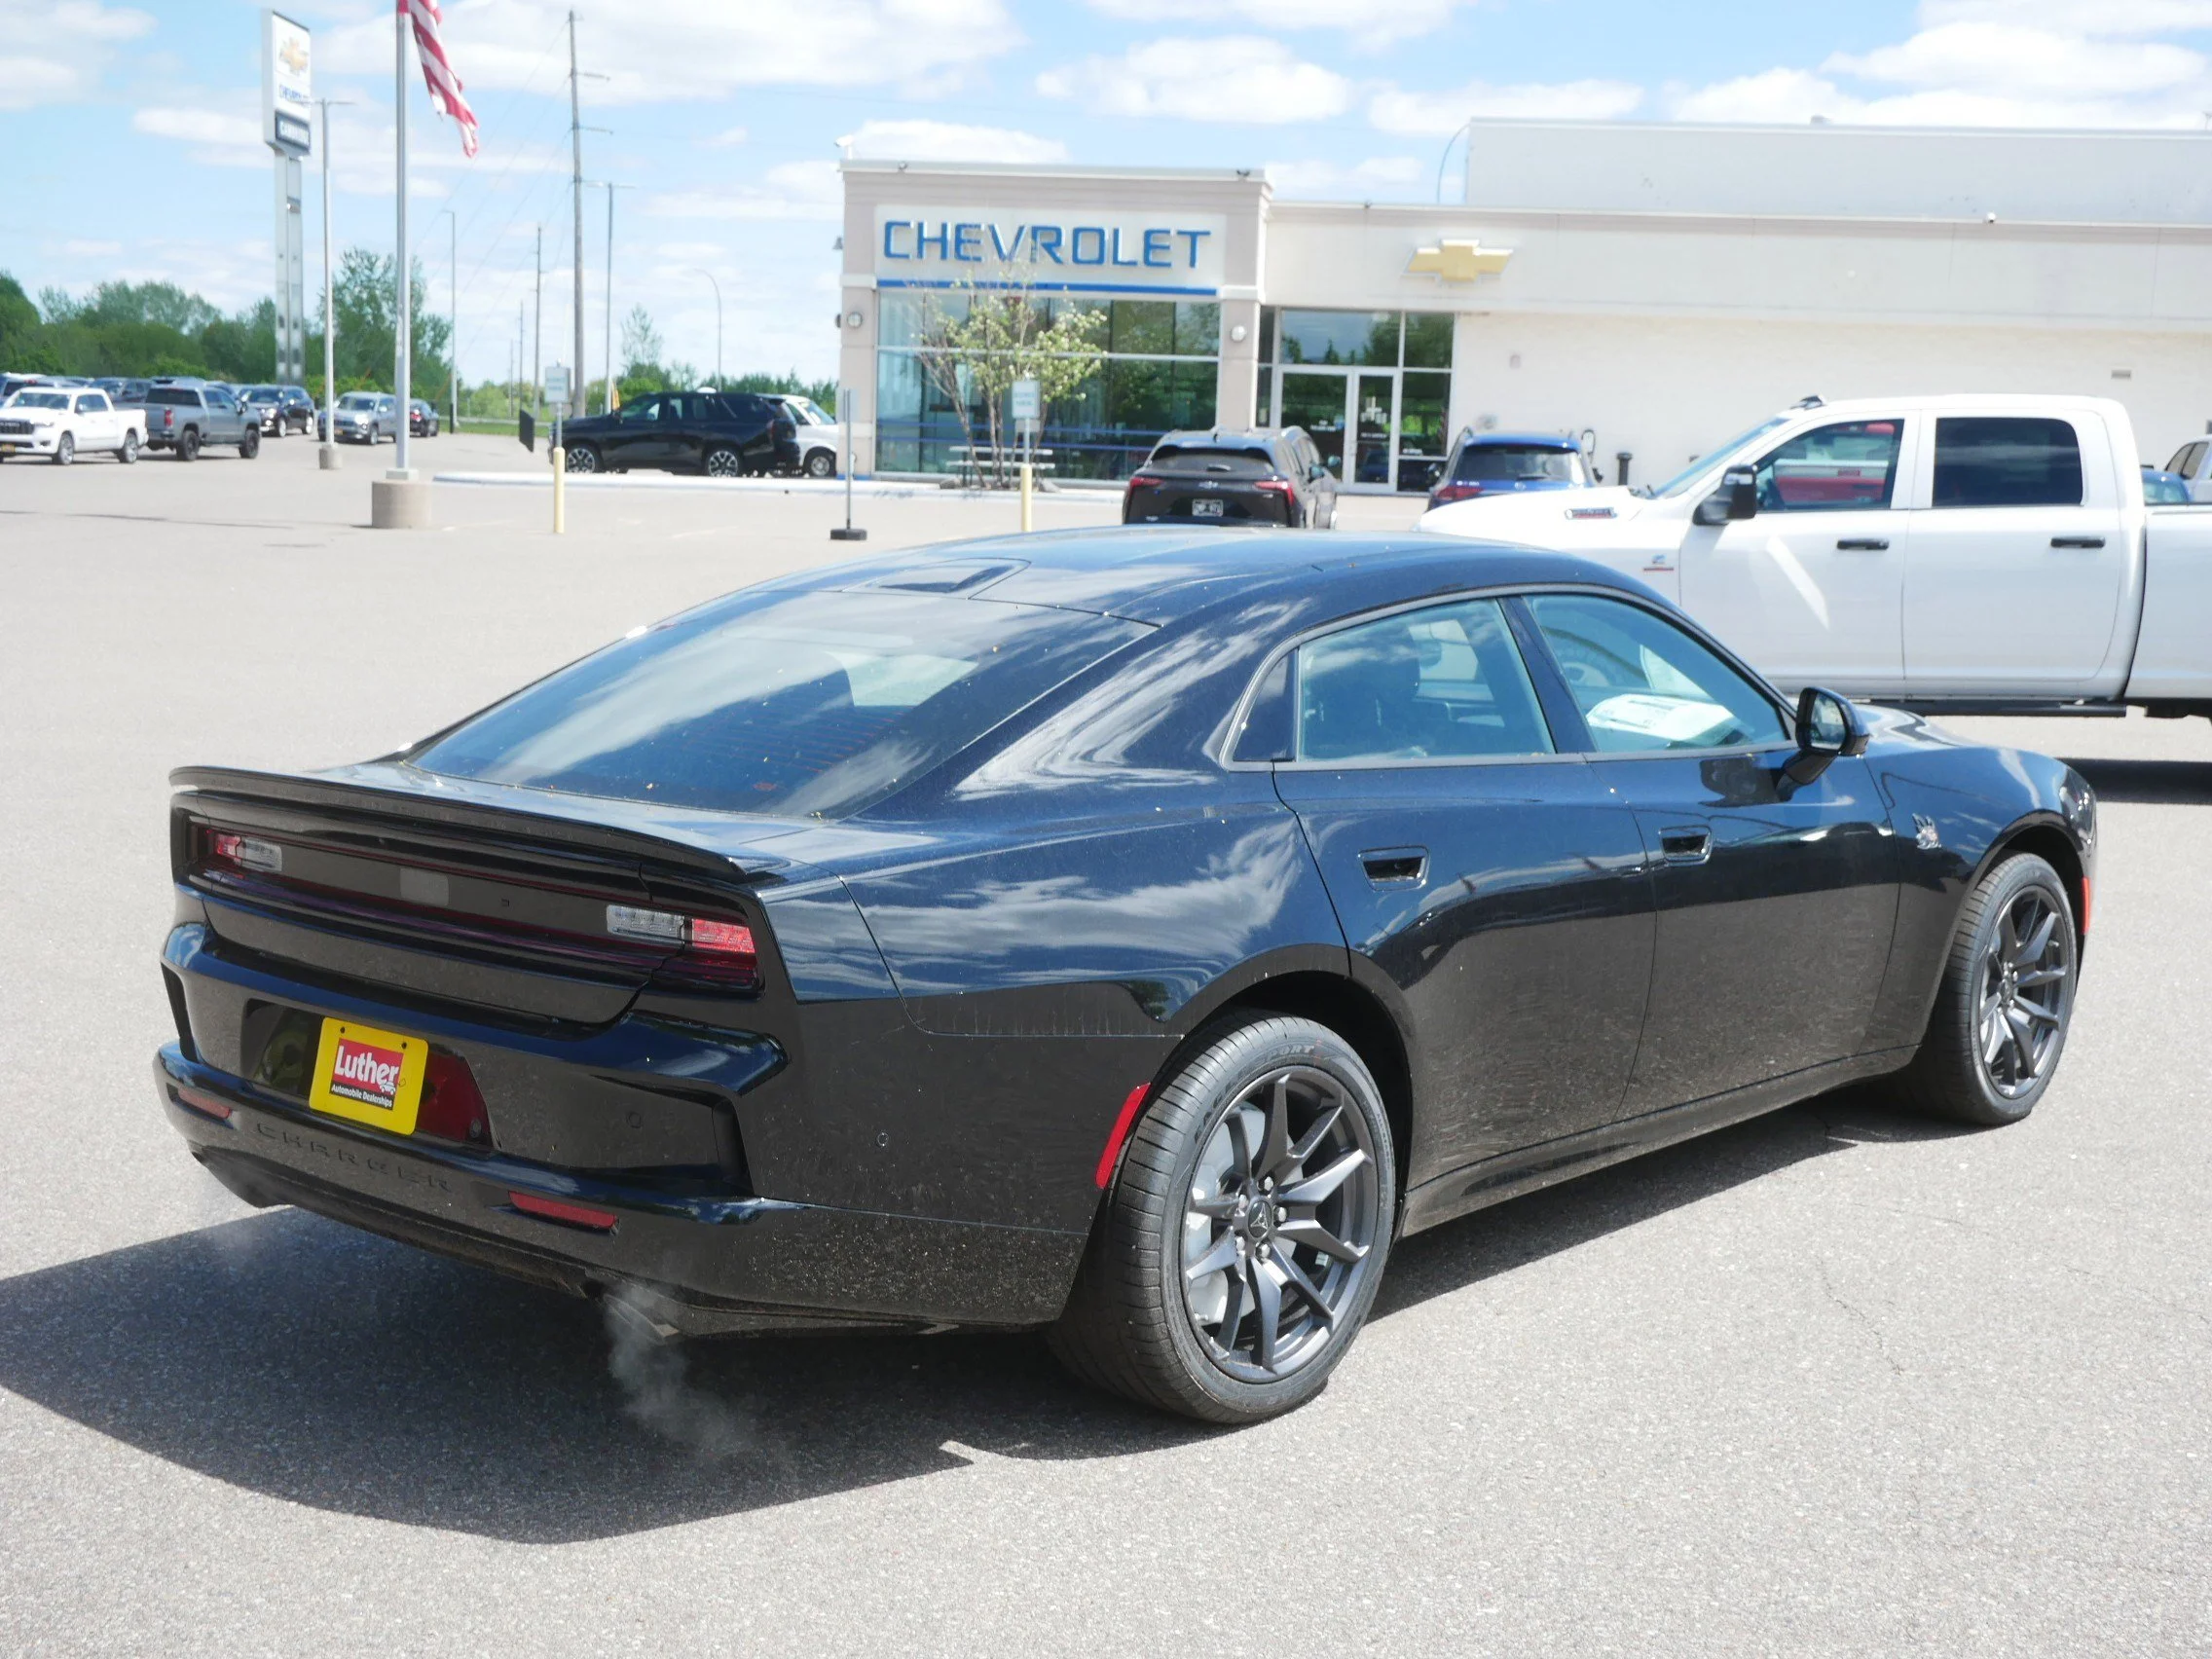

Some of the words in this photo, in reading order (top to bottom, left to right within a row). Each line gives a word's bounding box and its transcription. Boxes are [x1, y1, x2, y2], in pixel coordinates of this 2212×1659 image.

[883, 220, 1211, 269] CHEVROLET
[334, 1045, 399, 1086] Luther
[331, 1084, 362, 1098] Automobile
[362, 1091, 392, 1107] Dealerships
